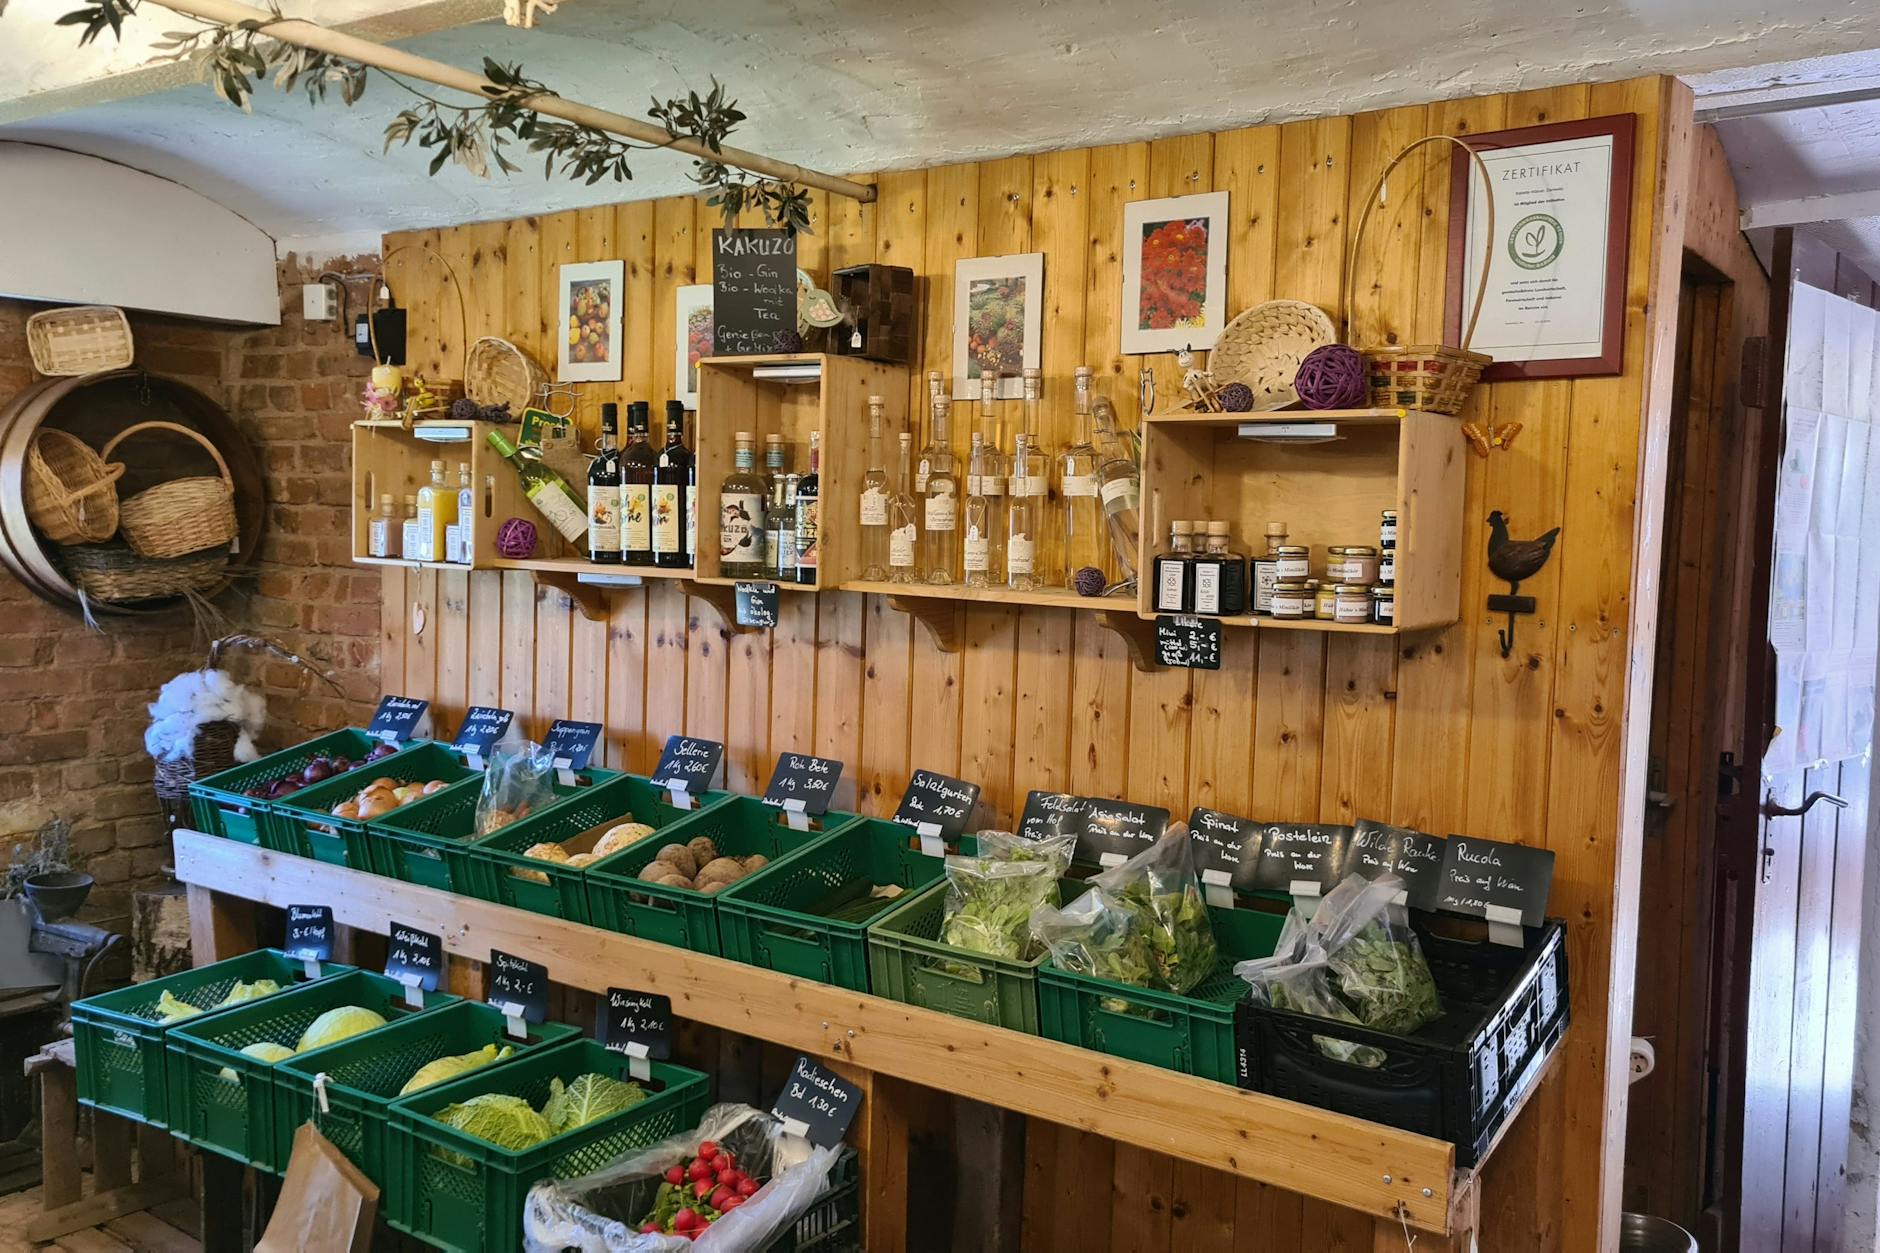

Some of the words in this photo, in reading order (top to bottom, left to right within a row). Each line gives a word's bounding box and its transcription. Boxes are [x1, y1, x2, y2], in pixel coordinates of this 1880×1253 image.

[1502, 161, 1581, 181] ZERTIFIKAT
[717, 236, 794, 257] KAKUZO
[717, 264, 742, 279] Bio
[757, 264, 779, 279] Gin
[719, 281, 739, 293] Bio
[753, 308, 781, 322] Tea
[674, 740, 710, 758] Sellerie
[913, 774, 973, 806] Salatgurken
[1026, 817, 1044, 825] vom
[1200, 813, 1240, 833] Spinat
[1268, 826, 1332, 844] Postelein
[1456, 842, 1502, 867] Rucola
[1449, 868, 1472, 884] Preis
[797, 1057, 849, 1103] Radieschen
[790, 1082, 807, 1100] Bd
